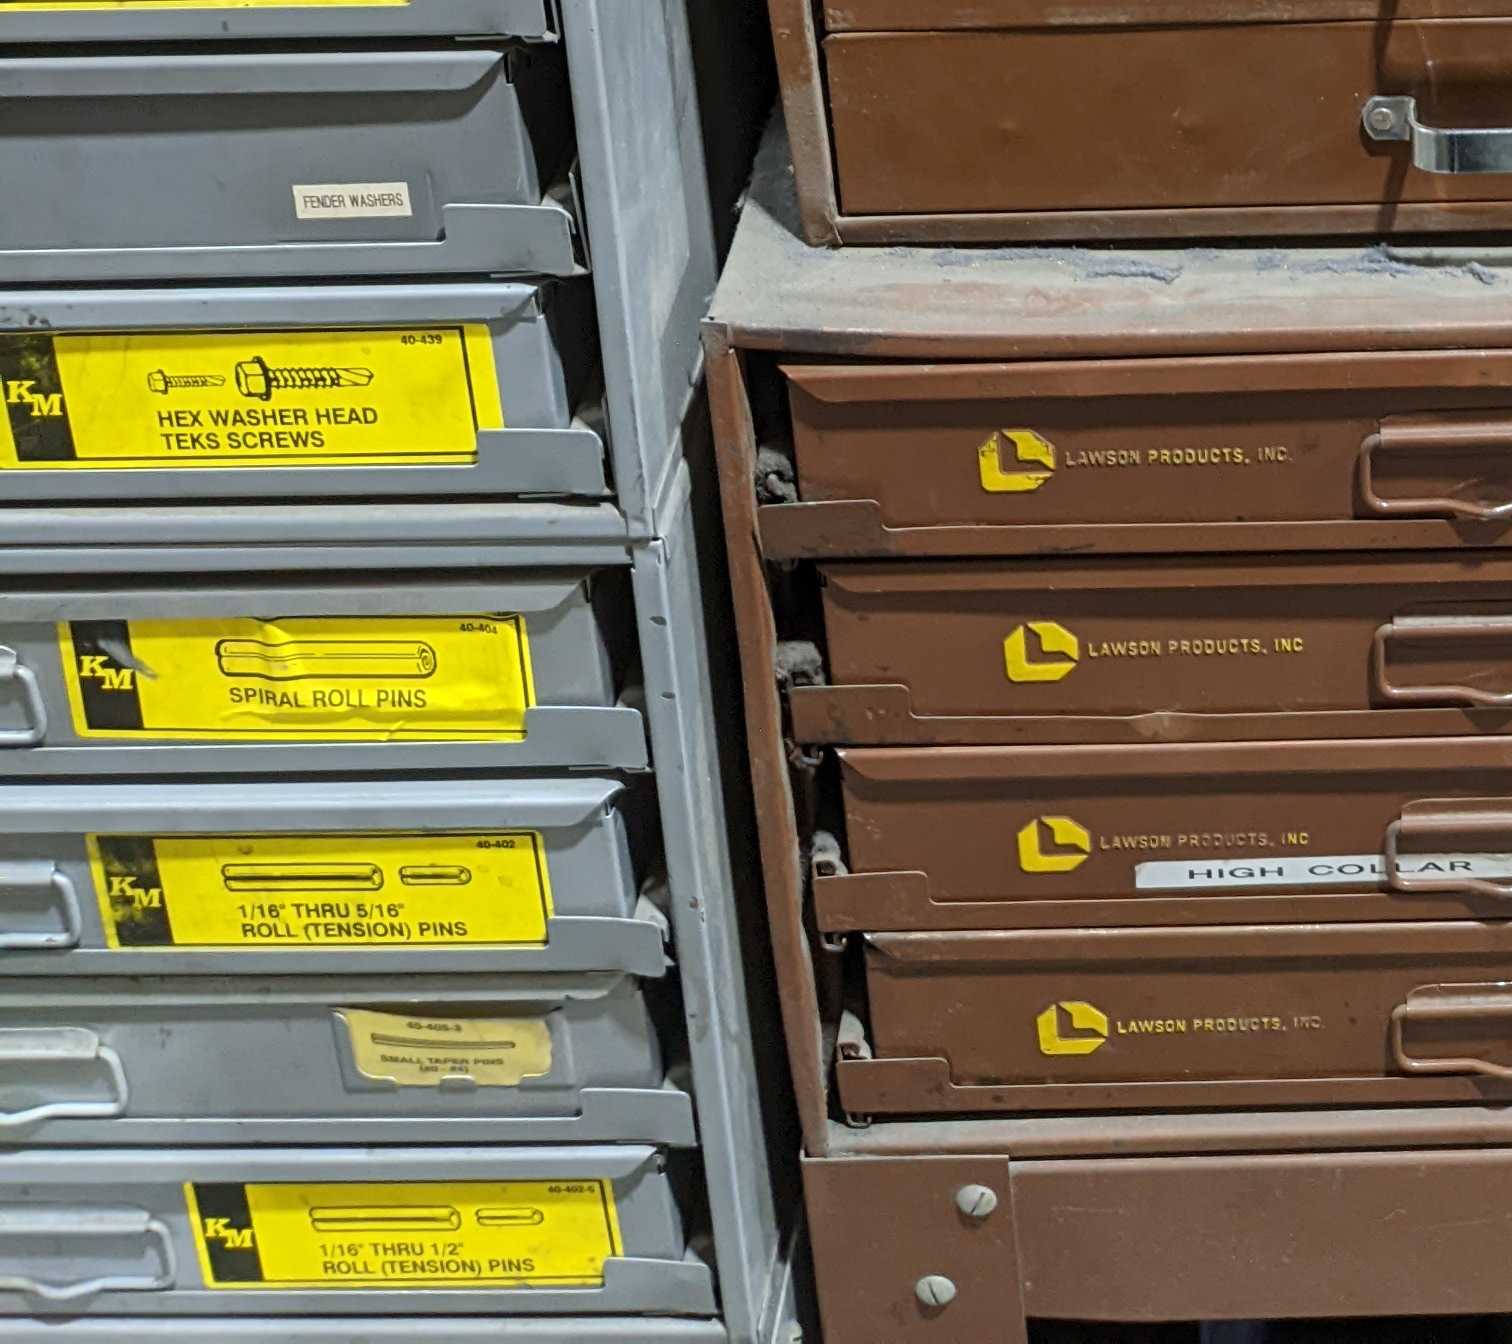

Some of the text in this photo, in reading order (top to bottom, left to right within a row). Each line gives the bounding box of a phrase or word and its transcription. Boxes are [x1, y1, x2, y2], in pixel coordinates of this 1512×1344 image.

[303, 193, 404, 208] FENDER WASHERS
[157, 407, 379, 428] HEX WASHER HEAD
[160, 430, 325, 451] TEKS SCREWS
[1065, 446, 1293, 468] LAWSON PRODUCTS, INC.
[1088, 640, 1161, 658] LAWSON
[1168, 638, 1268, 656] PRODUCTS,
[229, 686, 426, 709] SPIRAL ROLL PINS
[1100, 834, 1170, 850] LAWSON
[1188, 865, 1284, 880] HIGH
[1308, 861, 1473, 878] COLLAR
[238, 903, 405, 920] 1/16" THRU 5/16"
[241, 921, 468, 941] ROLL (TENSION) PINS
[1116, 1019, 1186, 1035] LAWSON
[1193, 1017, 1287, 1033] PRODUCTS,
[372, 1242, 424, 1257] THRU
[322, 1258, 535, 1277] ROLL (TENSION) PINS
